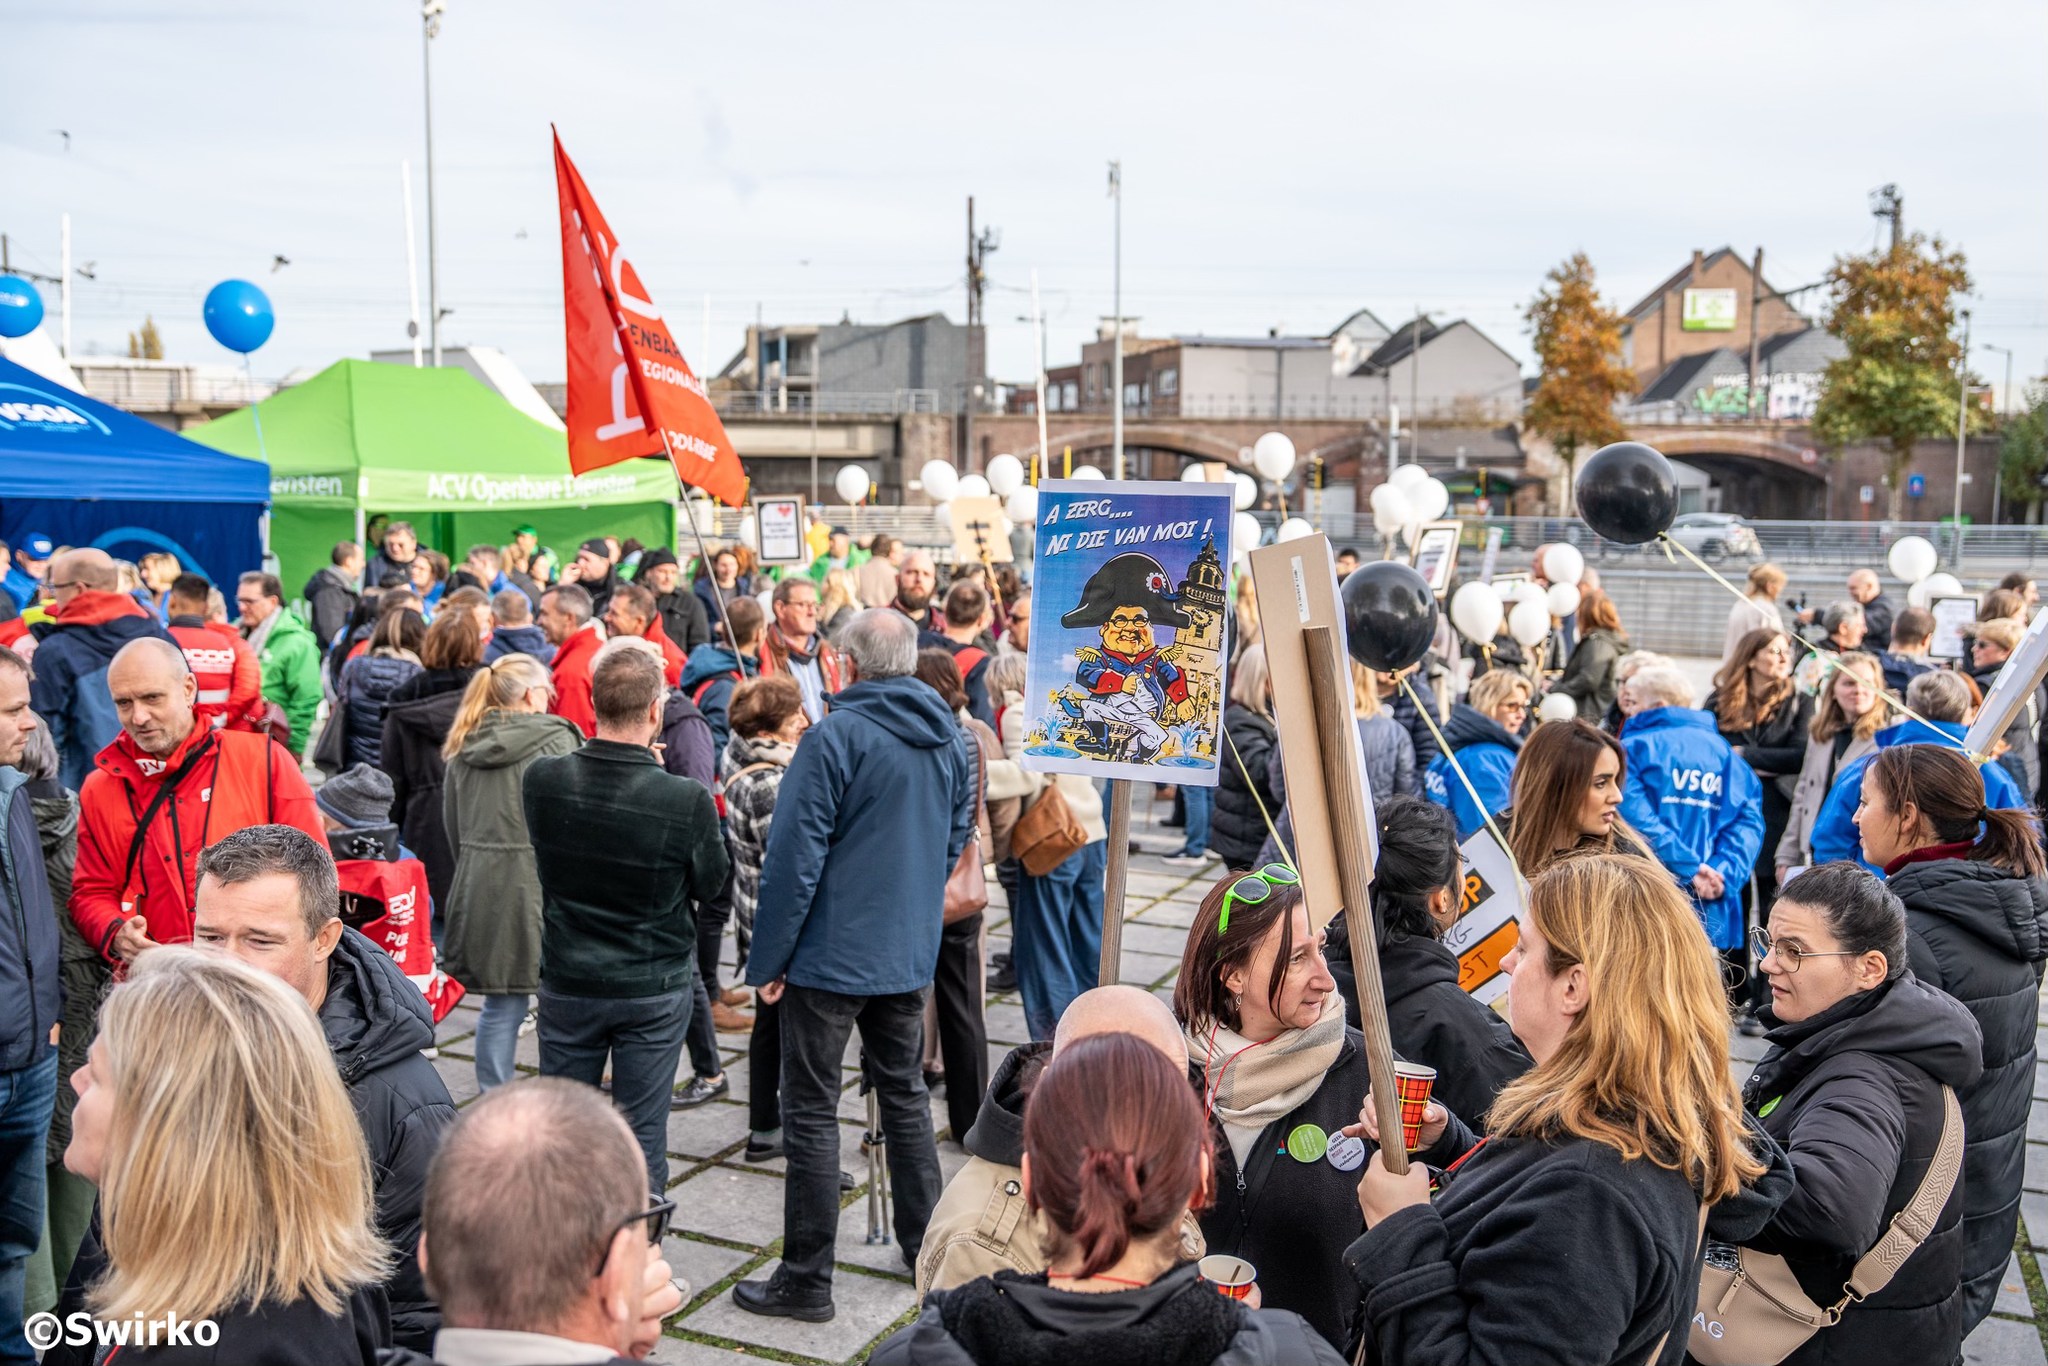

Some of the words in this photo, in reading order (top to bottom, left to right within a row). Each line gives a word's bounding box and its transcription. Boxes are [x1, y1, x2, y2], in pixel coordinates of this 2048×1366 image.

[428, 474, 468, 499] ACV
[471, 474, 562, 506] Openbare
[1043, 504, 1061, 527] A
[1045, 533, 1073, 557] NI
[1075, 530, 1109, 550] DIE
[1114, 525, 1151, 546] VAN
[1152, 520, 1198, 543] MOI
[1671, 767, 1722, 798] VSOA
